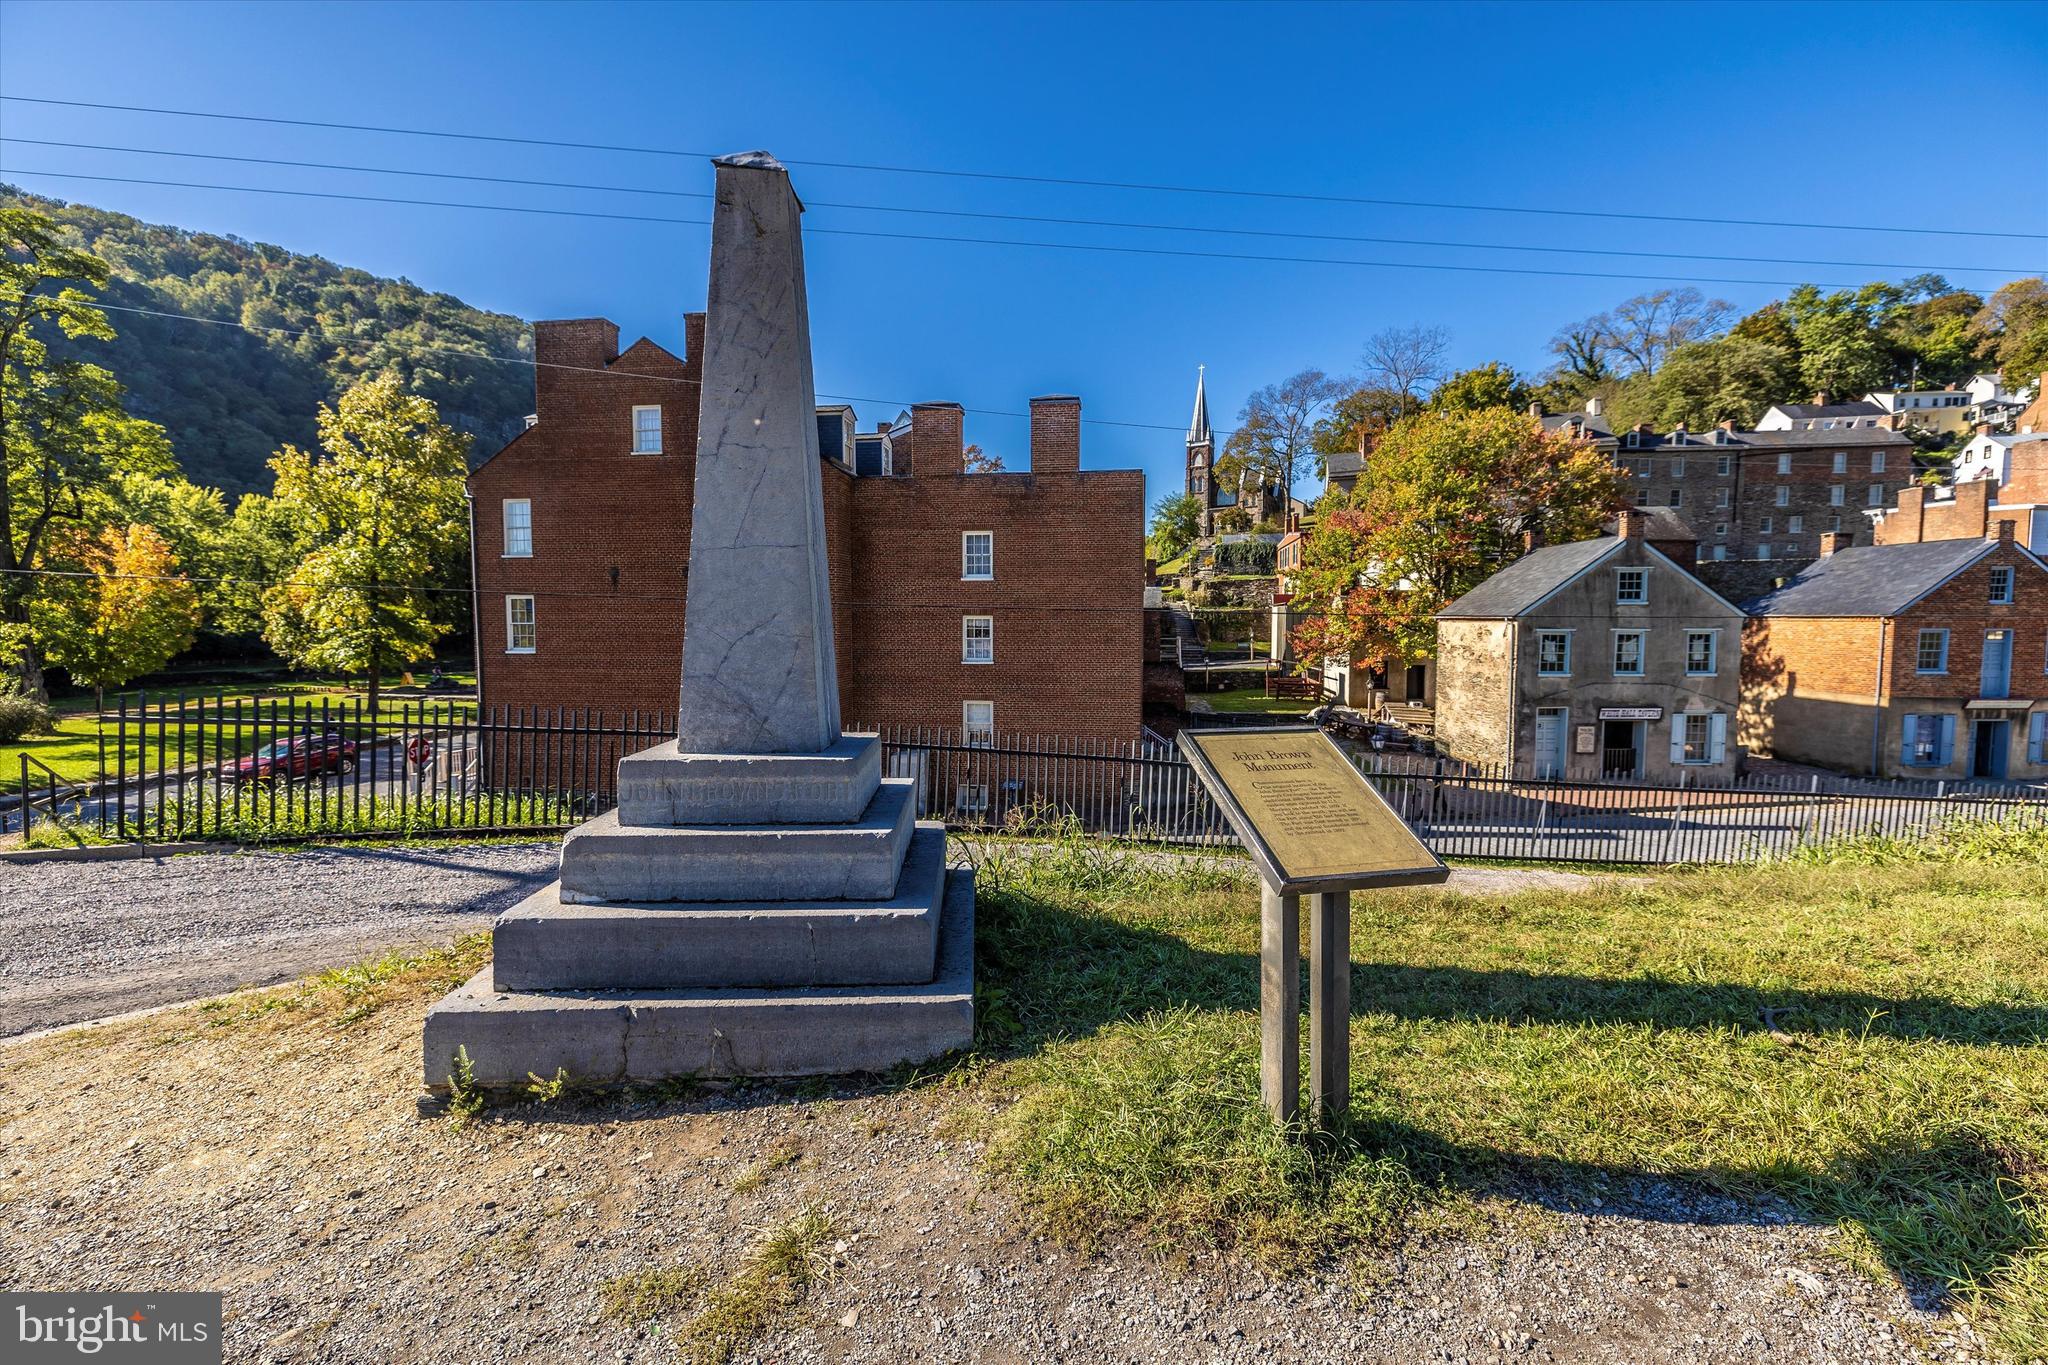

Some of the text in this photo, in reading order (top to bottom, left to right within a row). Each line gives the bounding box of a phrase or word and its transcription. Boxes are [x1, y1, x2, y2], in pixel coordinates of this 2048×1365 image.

[1232, 750, 1312, 762] John Brown
[1242, 761, 1313, 772] Monument
